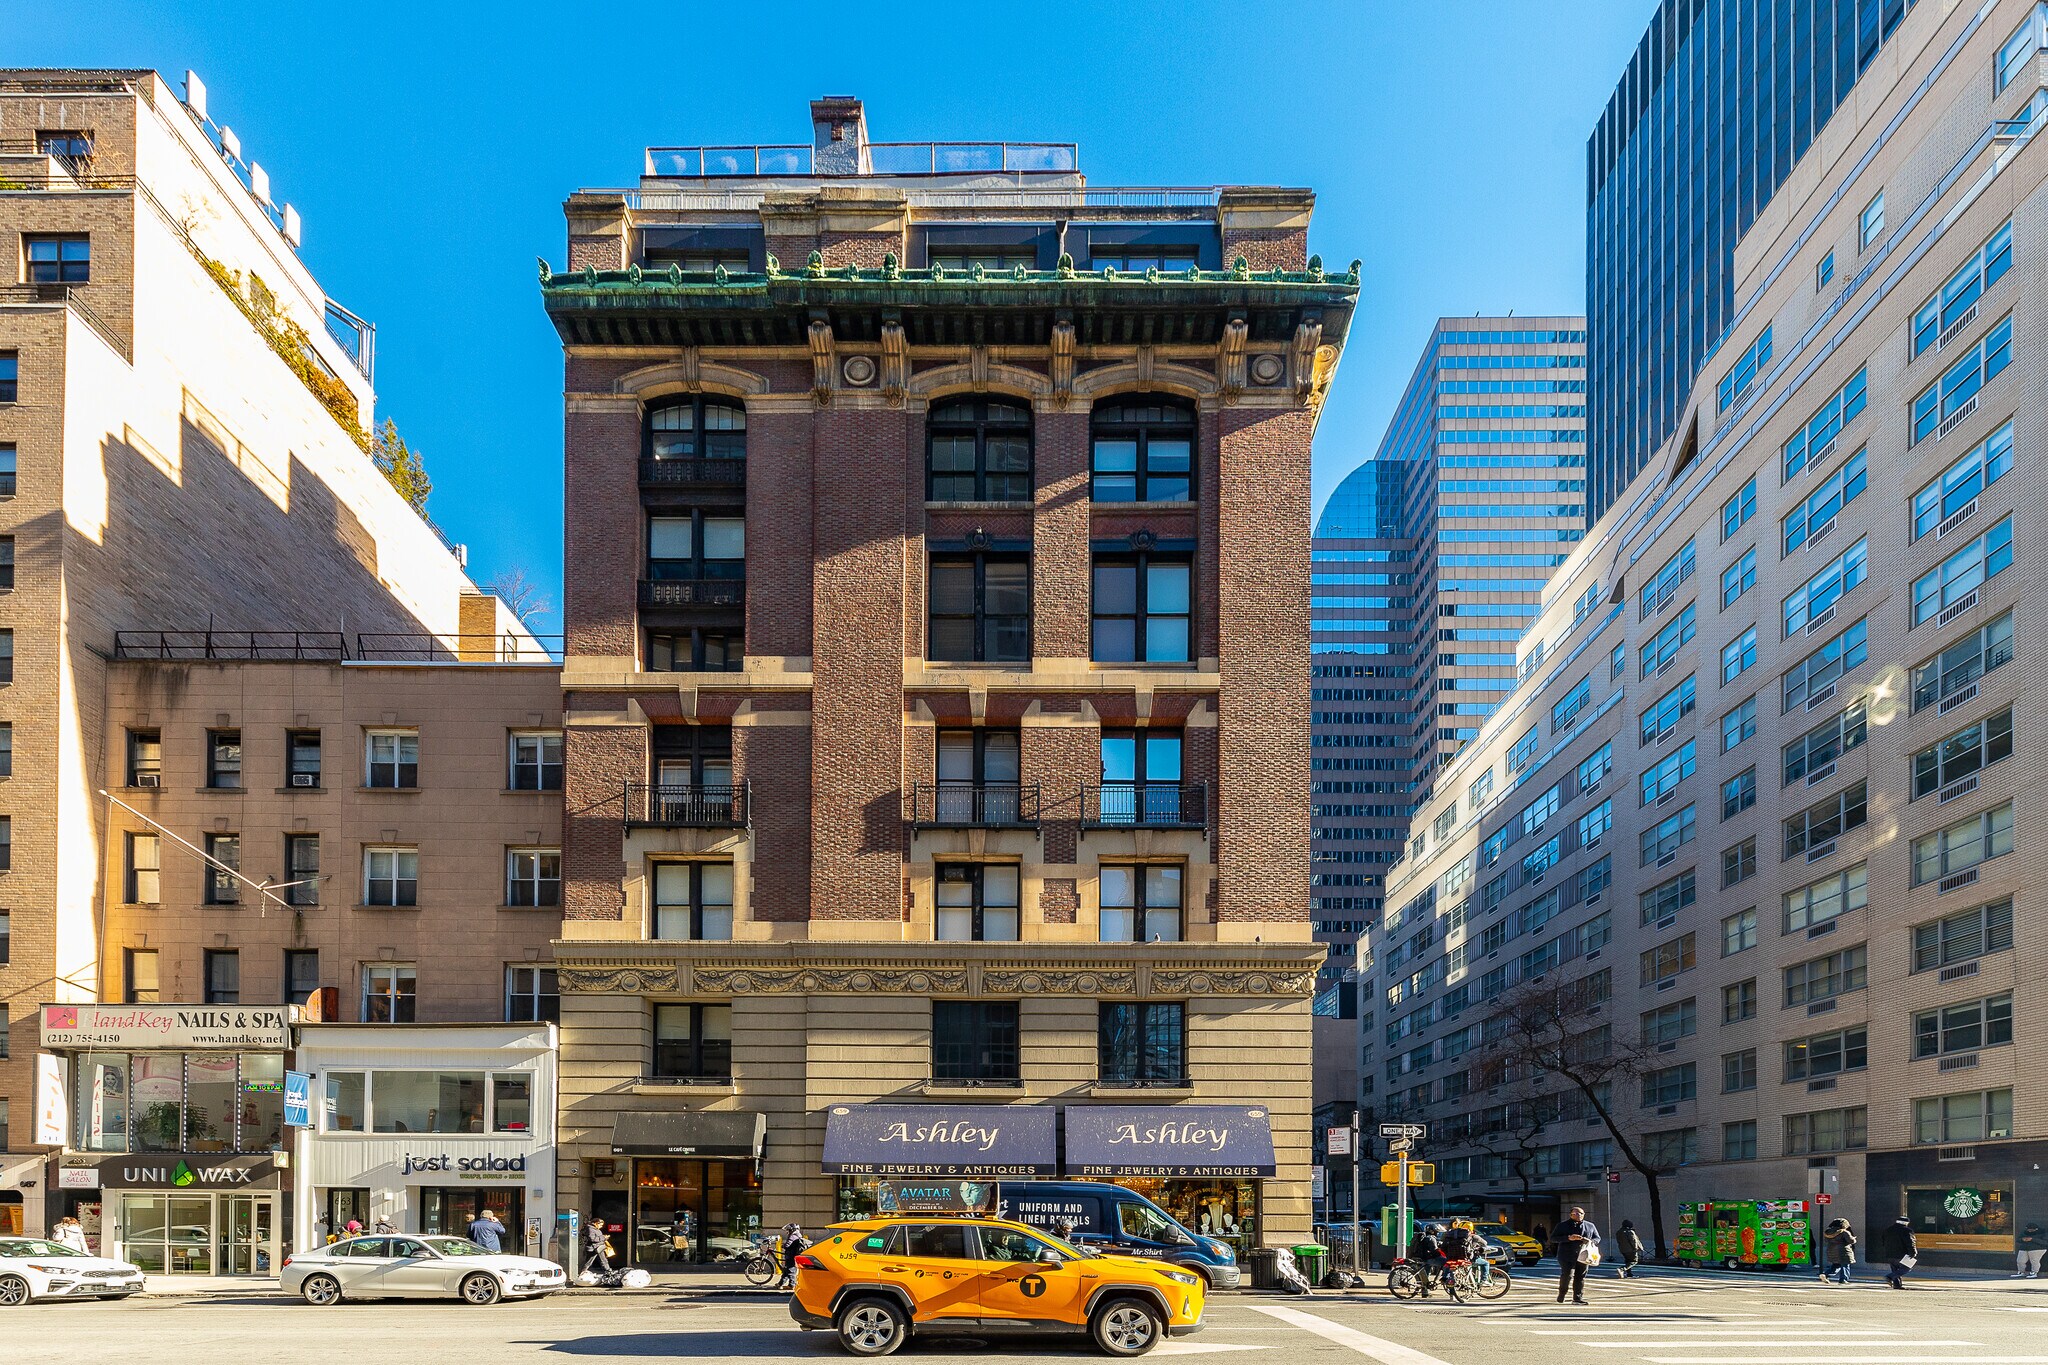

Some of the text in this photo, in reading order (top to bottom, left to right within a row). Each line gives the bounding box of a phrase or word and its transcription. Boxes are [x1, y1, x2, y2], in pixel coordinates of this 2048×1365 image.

[177, 1012, 230, 1028] NAILS
[234, 1012, 247, 1028] &
[252, 1012, 284, 1029] SPA
[47, 1034, 120, 1043] (212) 755-4150
[192, 1034, 283, 1045] www.handkey.net
[878, 1121, 999, 1151] Ashley
[1108, 1122, 1228, 1151] Ashley
[458, 1152, 526, 1172] salad
[123, 1167, 252, 1182] UNI WAX
[841, 1164, 1036, 1174] FINE JEWELRY & ANTIQUES
[1083, 1166, 1259, 1176] FINE JEWELRY & ANTIQUES
[900, 1187, 952, 1198] AVATAR
[1019, 1202, 1060, 1213] UNIFORM
[1064, 1203, 1083, 1214] AND
[1018, 1214, 1045, 1224] LINEN
[1025, 1278, 1041, 1295] T
